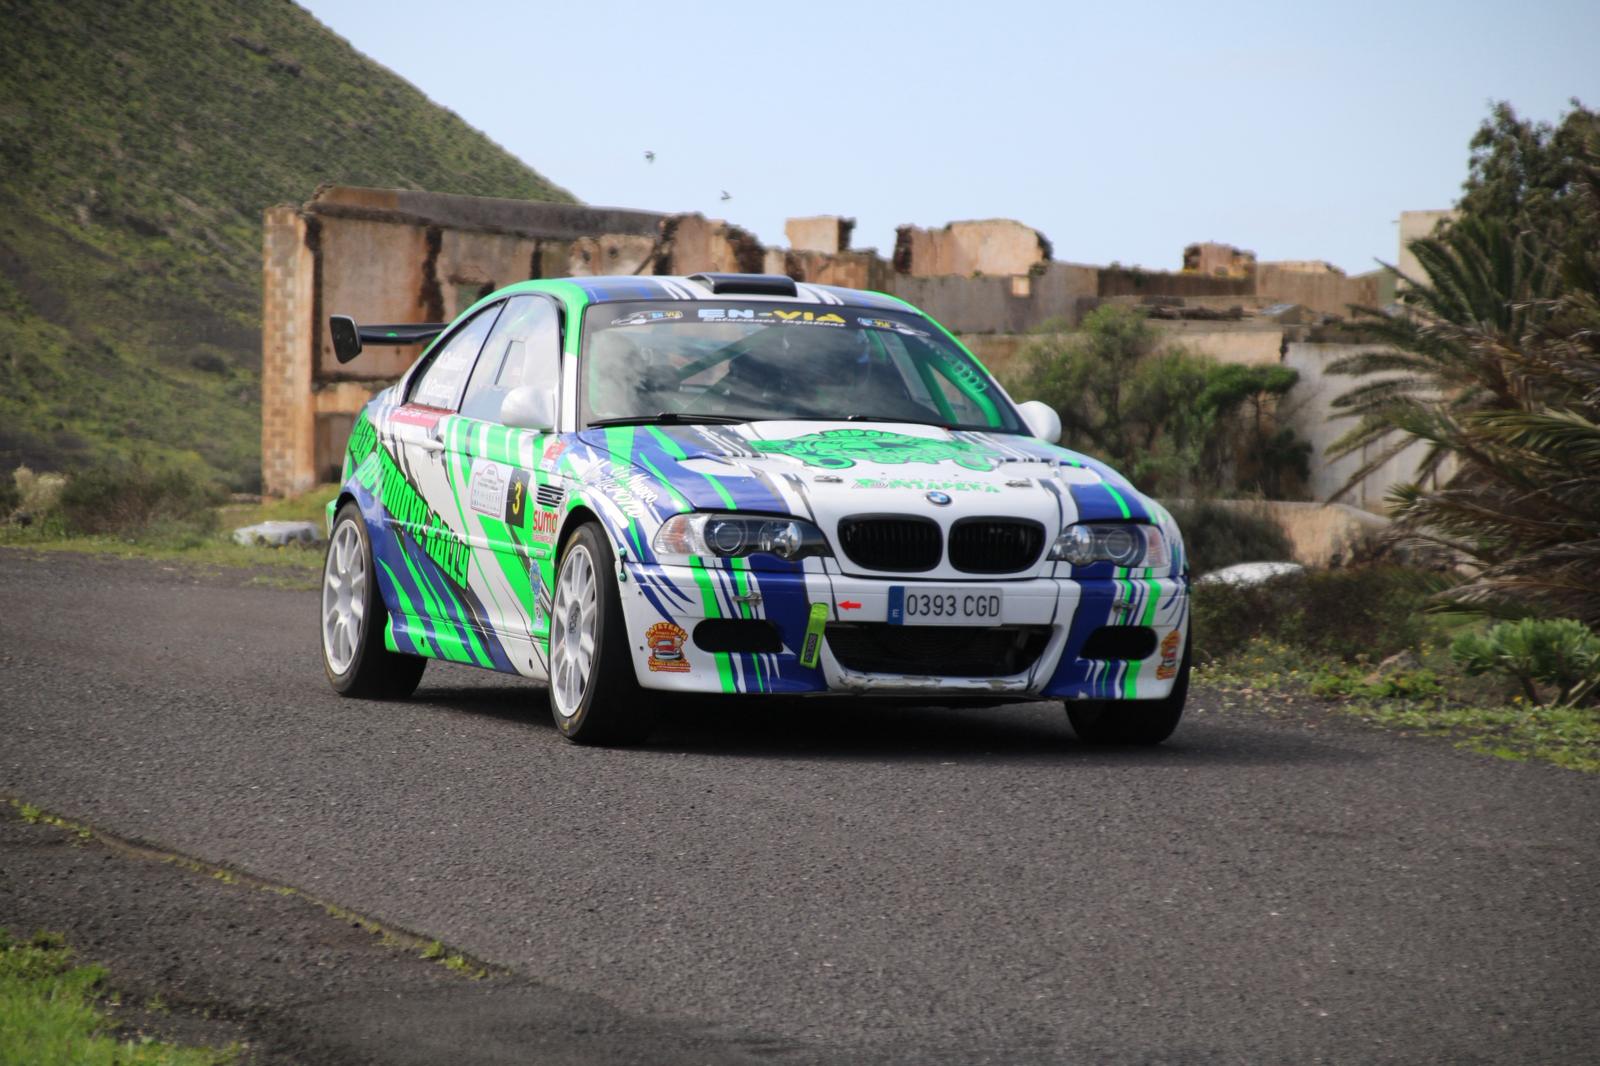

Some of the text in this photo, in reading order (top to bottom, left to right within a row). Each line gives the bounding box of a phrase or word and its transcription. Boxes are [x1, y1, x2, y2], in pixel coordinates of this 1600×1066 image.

[512, 480, 523, 515] 3
[906, 594, 1000, 618] 0393 CGD
